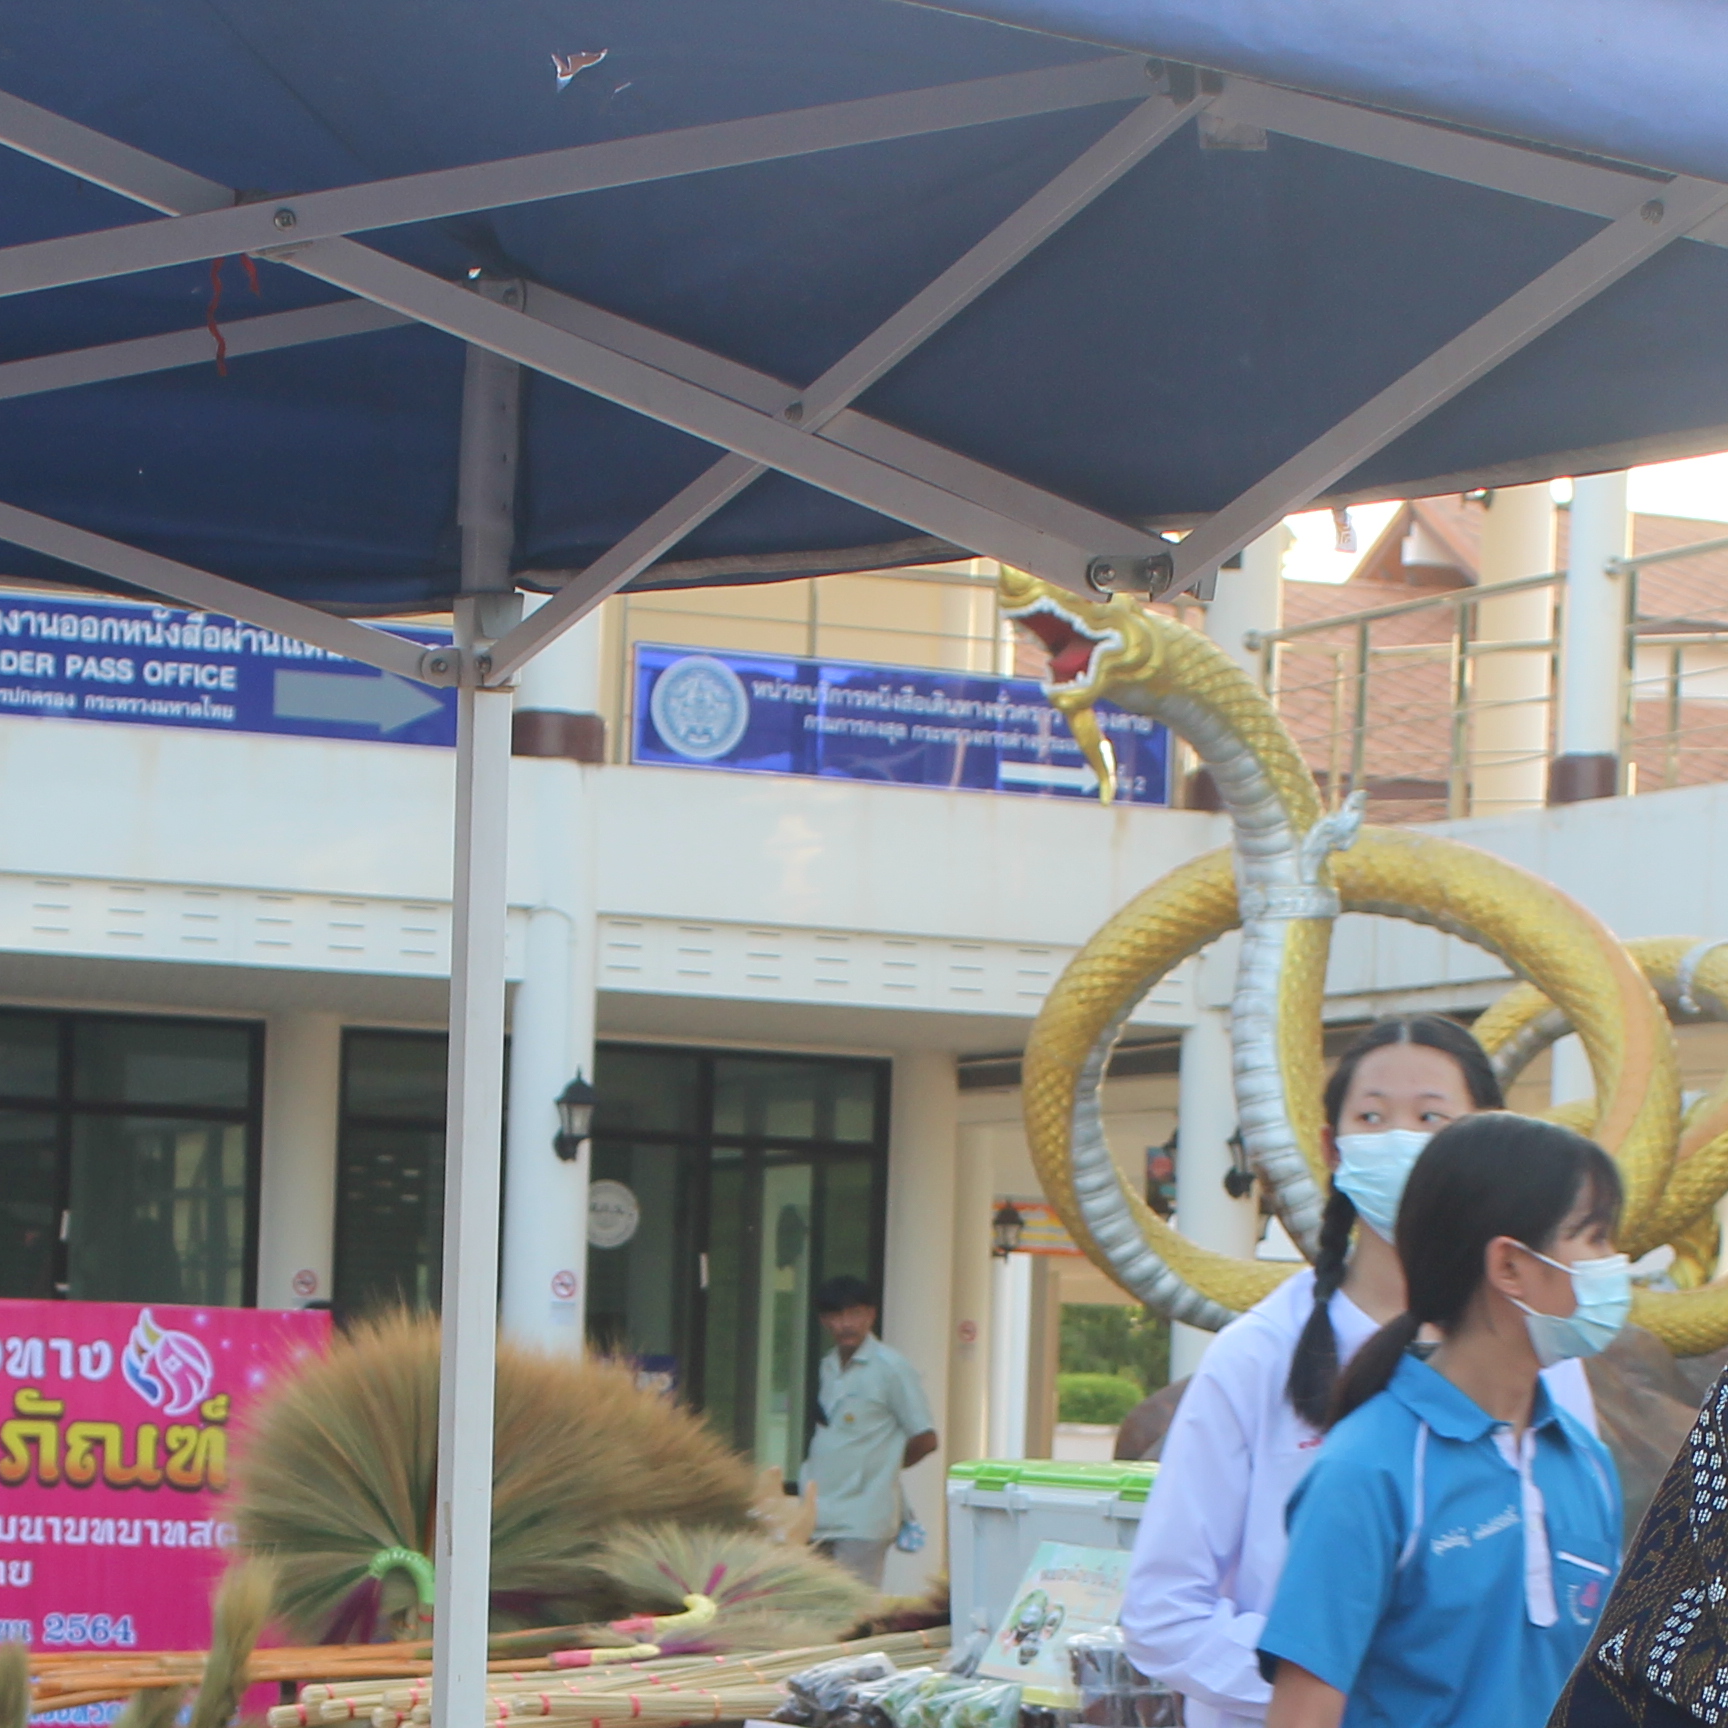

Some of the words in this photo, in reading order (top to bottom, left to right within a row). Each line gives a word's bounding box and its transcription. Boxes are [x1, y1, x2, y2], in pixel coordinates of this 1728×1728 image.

[65, 653, 136, 684] PASS
[143, 660, 239, 691] OFFICE
[42, 1612, 138, 1647] 2564
